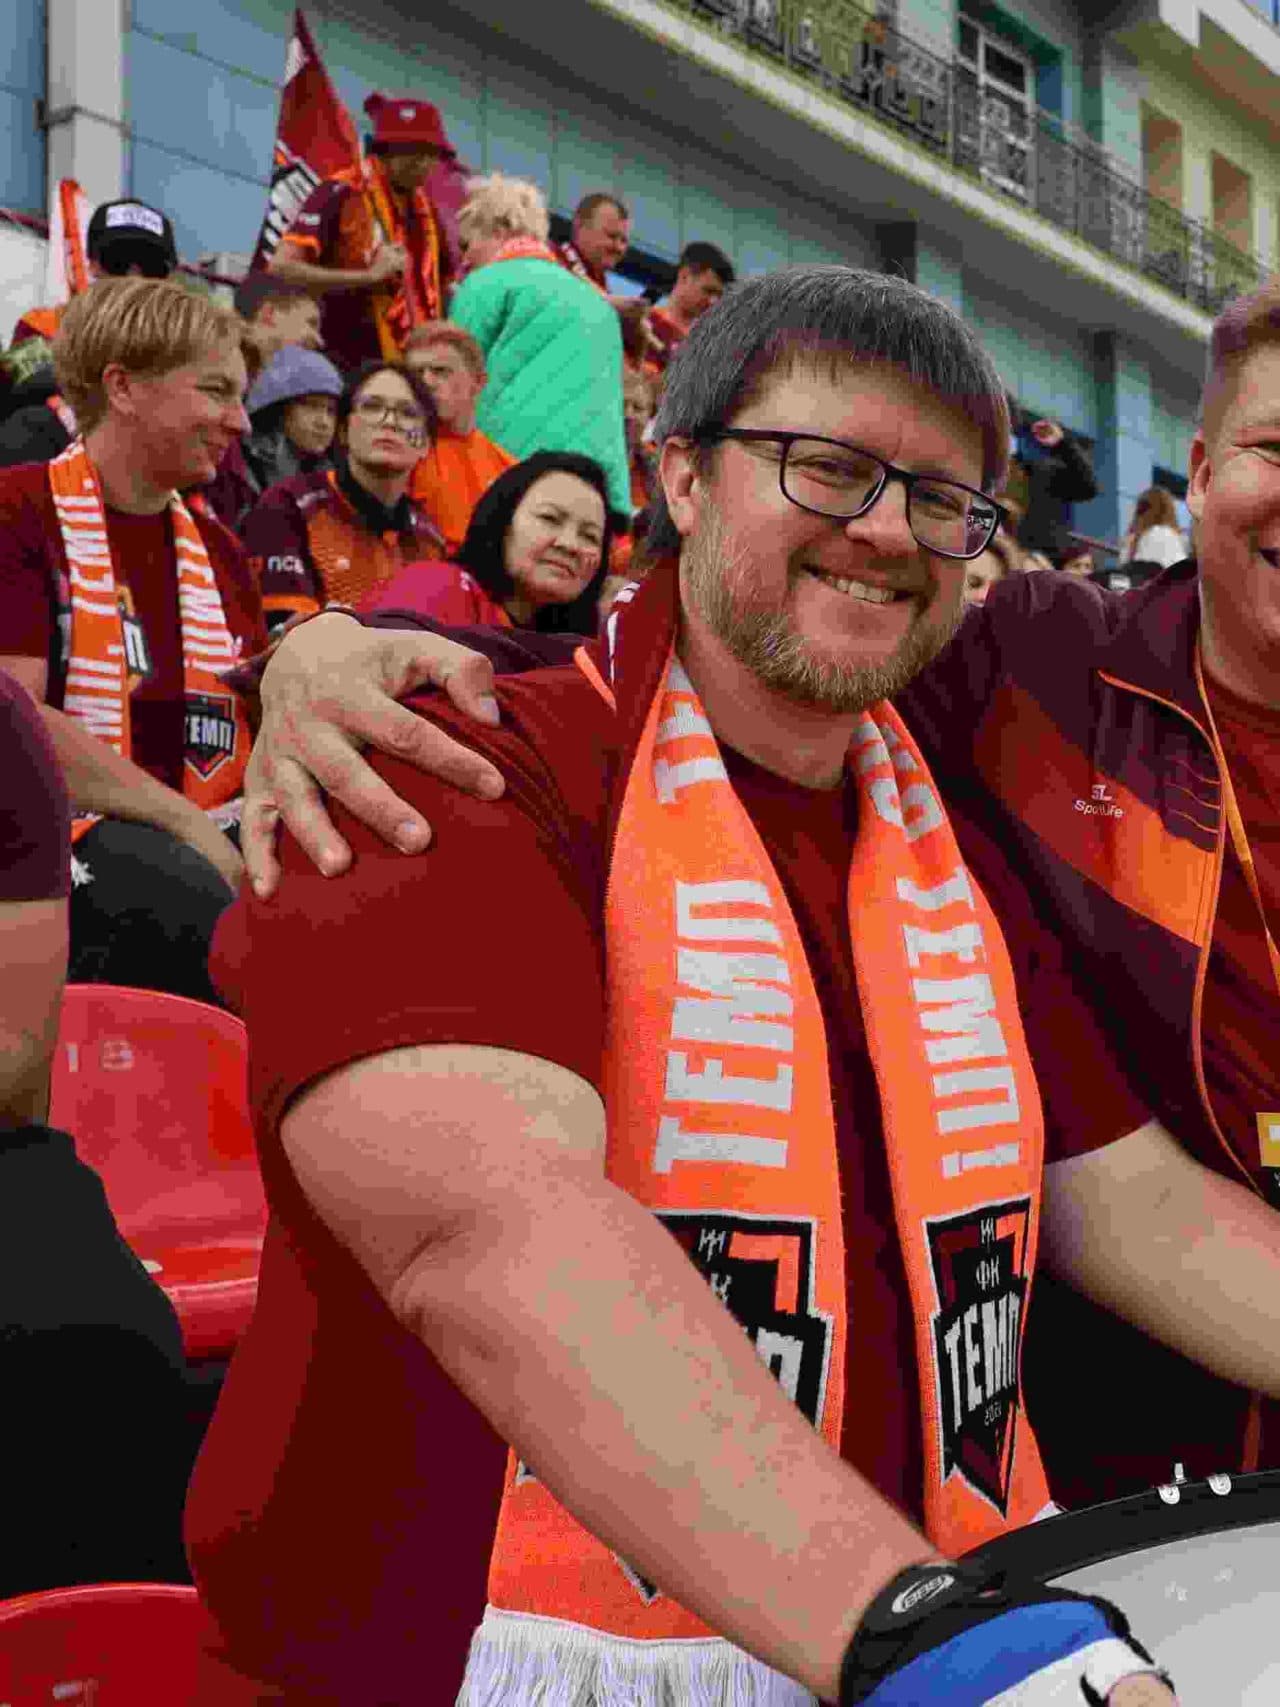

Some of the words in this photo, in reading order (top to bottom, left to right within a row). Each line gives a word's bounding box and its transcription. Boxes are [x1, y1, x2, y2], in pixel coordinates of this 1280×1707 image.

[652, 879, 795, 1176] ТЕМП
[896, 866, 1021, 1179] ТЕМП!
[944, 1290, 1021, 1434] ТЕМП
